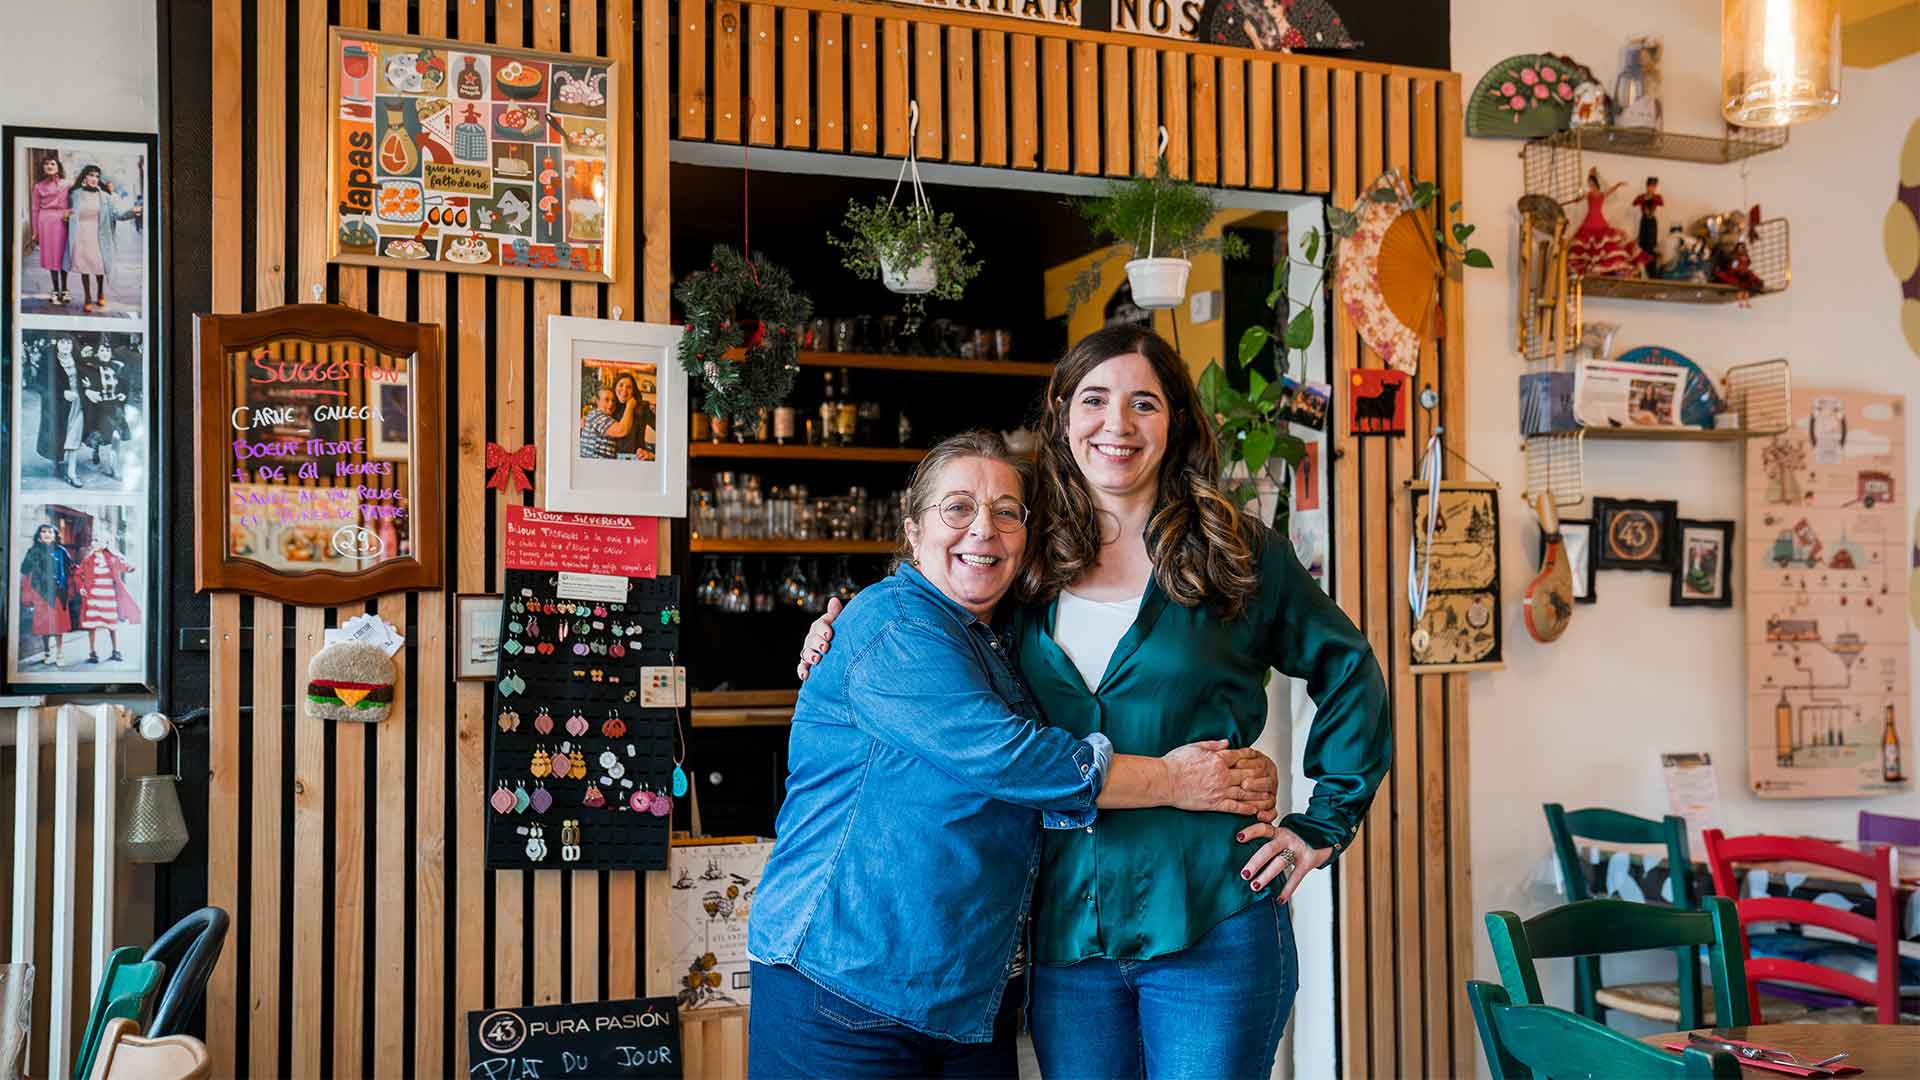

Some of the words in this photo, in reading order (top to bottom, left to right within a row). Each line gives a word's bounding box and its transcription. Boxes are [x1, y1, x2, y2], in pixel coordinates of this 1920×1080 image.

[1116, 0, 1201, 35] NOS
[425, 164, 446, 176] que
[447, 166, 462, 176] no
[231, 406, 296, 431] CARNE
[314, 405, 385, 423] GALLEGA
[259, 465, 287, 481] DE
[336, 462, 392, 477] HEURES
[357, 484, 403, 501] ROUGE
[1618, 520, 1647, 547] 43
[487, 1020, 517, 1042] 43
[530, 1018, 590, 1037] PURA
[595, 1005, 671, 1031] PASIÓN
[470, 1057, 544, 1080] PLAT
[562, 1051, 588, 1073] DU
[616, 1046, 673, 1067] JOUR
